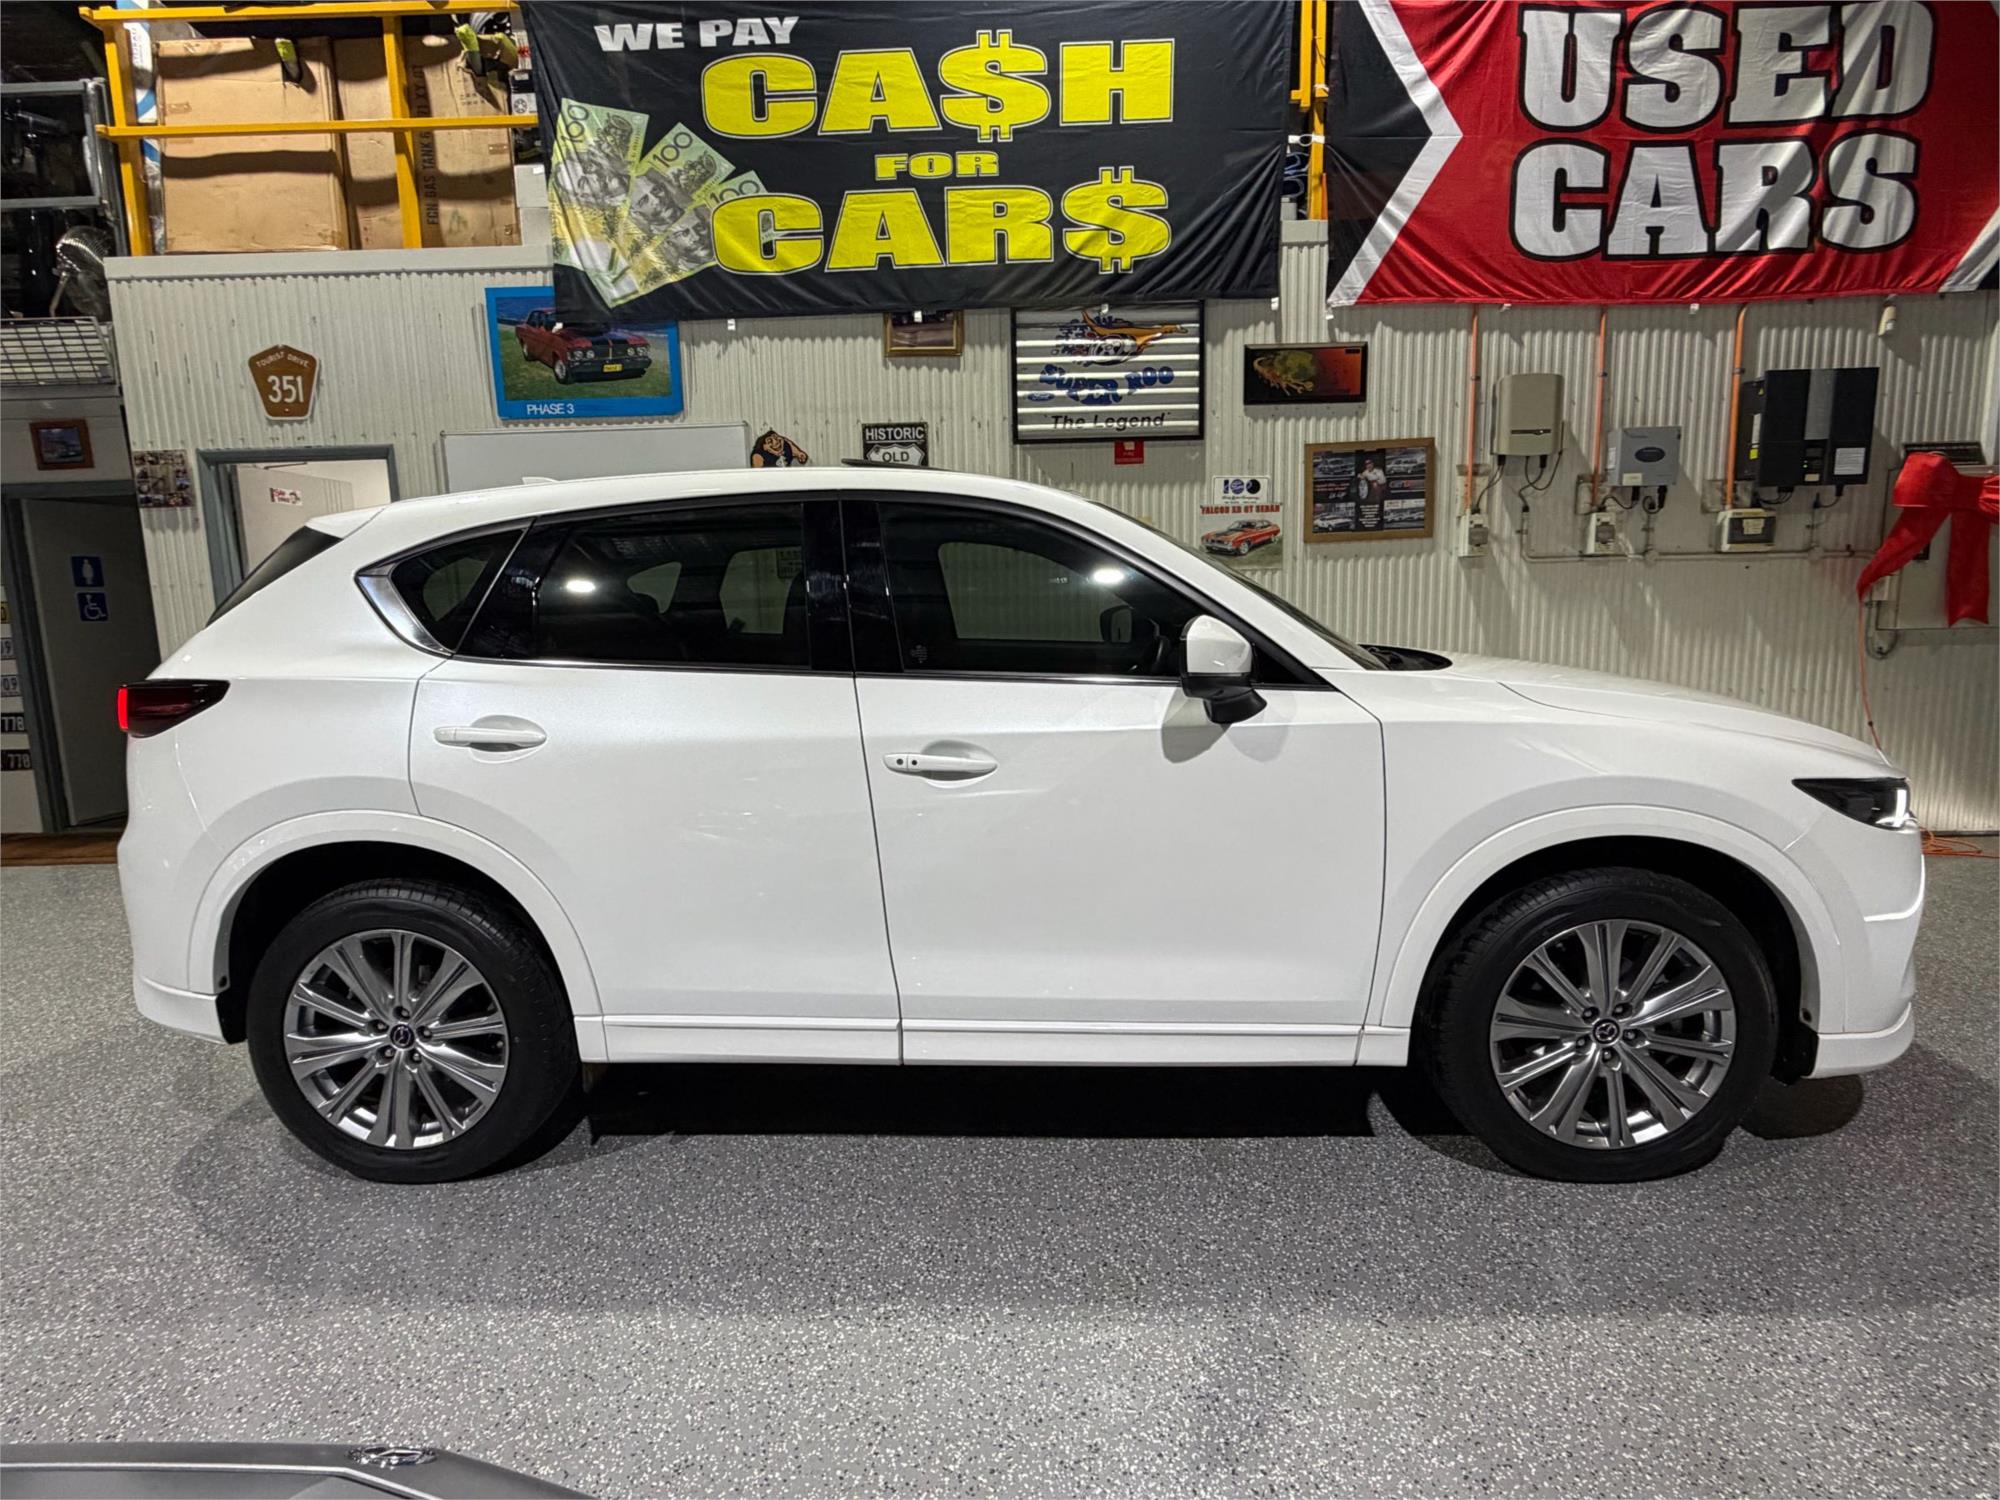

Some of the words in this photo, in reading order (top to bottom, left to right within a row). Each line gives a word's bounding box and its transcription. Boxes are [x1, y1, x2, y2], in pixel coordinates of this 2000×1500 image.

[594, 23, 684, 52] WE
[699, 16, 799, 46] PAY
[1519, 0, 1935, 131] USED
[701, 29, 1175, 143] CA$H
[420, 142, 435, 170] TANK
[652, 131, 694, 169] 100
[875, 151, 1000, 181] FOR
[1510, 131, 1920, 261] CARS
[711, 166, 1172, 276] CAR$
[267, 375, 305, 403] 351
[526, 402, 566, 415] PHASE
[566, 403, 575, 414] 3
[865, 427, 924, 440] HISTORIC
[882, 451, 910, 463] OLD
